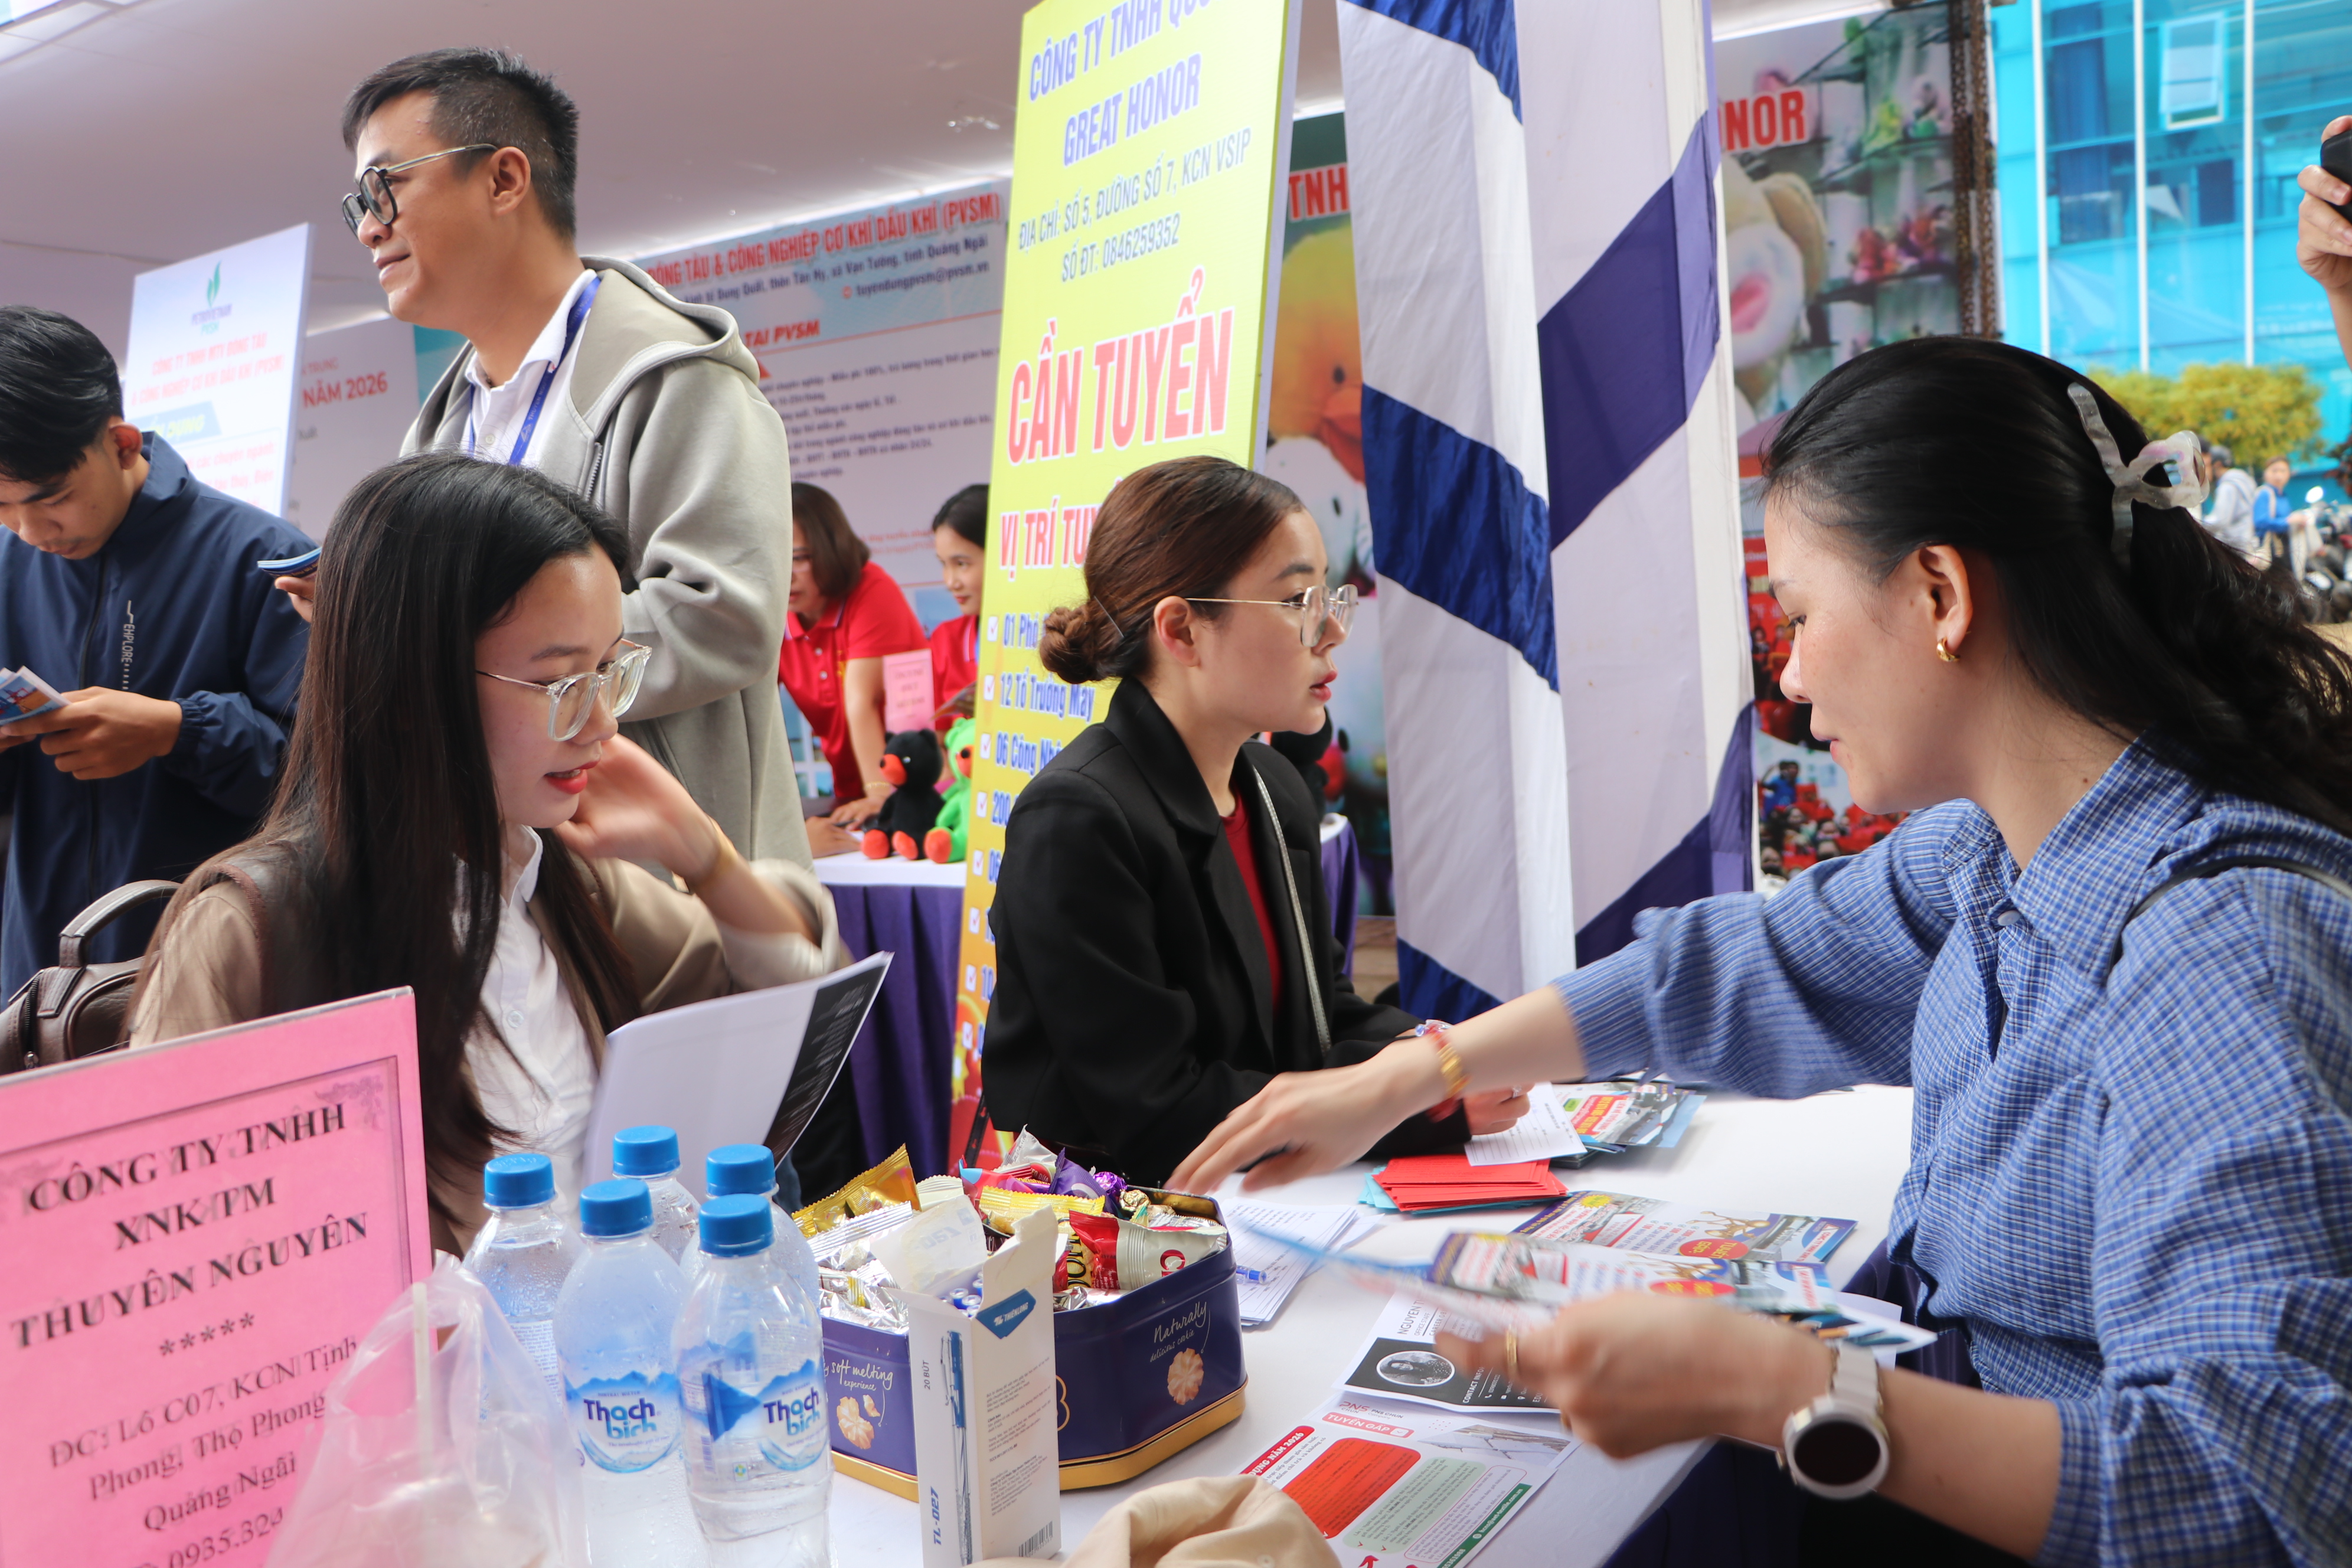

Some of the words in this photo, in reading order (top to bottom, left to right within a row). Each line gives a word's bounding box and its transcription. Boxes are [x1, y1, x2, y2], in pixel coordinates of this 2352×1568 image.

[1030, 32, 1078, 102] CÔNG
[1083, 15, 1106, 73] TY
[1064, 92, 1122, 167] GREAT
[1126, 52, 1201, 138] HONOR
[1718, 90, 1805, 152] NOR
[1020, 216, 1037, 254] ĐỊA
[1064, 187, 1083, 233] SỐ
[1082, 195, 1092, 228] 5,
[1096, 174, 1140, 219] ĐƯỜNG
[1144, 151, 1166, 202] SỐ
[1167, 159, 1177, 195] 7,
[1182, 143, 1212, 187] KCN
[1216, 127, 1252, 172] VSIP
[685, 252, 709, 282] TÀU
[714, 253, 724, 276] &
[728, 243, 765, 273] CÔNG
[769, 229, 819, 263] NGHIỆP
[824, 223, 844, 253] CƠ
[847, 214, 872, 247] KHÍ
[911, 201, 937, 234] KHÍ
[942, 192, 1000, 228] (PVSM)
[1062, 237, 1080, 282] SỐ
[1080, 243, 1099, 276] ĐT:
[1103, 212, 1181, 268] 0846259352
[773, 319, 821, 343] PVSM
[1008, 318, 1083, 465] CẦN
[1093, 266, 1234, 452] TUYỂN
[303, 379, 342, 409] NĂM
[346, 371, 388, 400] 2026
[1000, 511, 1020, 581] VỊ
[1024, 495, 1059, 567] TRÍ
[1004, 613, 1015, 648] 01
[1018, 612, 1039, 649] Phó
[1000, 672, 1012, 707] 12
[1030, 671, 1066, 720] Trưởng
[1069, 682, 1096, 723] May
[996, 731, 1008, 766] 06
[1011, 733, 1037, 778] Công
[991, 789, 1010, 828] 200
[29, 1153, 158, 1213] CÔNG
[172, 1136, 222, 1173] TY
[237, 1103, 345, 1155] TNHH
[115, 1198, 201, 1250] XNK
[214, 1178, 276, 1219] TM
[11, 1268, 198, 1349] THUYÊN
[210, 1214, 369, 1288] NGUYÊN
[1154, 1301, 1207, 1343] Naturally
[1397, 1306, 1422, 1335] NGUYEN
[1414, 1322, 1426, 1336] OFFICE
[1421, 1312, 1430, 1324] STAFF
[1429, 1318, 1442, 1336] CAREER
[1150, 1341, 1175, 1362] delicious
[1177, 1329, 1194, 1345] cookie
[832, 1359, 851, 1384] soft
[852, 1363, 893, 1390] melting
[844, 1380, 877, 1391] experience
[925, 1378, 930, 1390] 20
[1463, 1380, 1478, 1403] CONTACT
[51, 1429, 110, 1468] ĐC:
[119, 1410, 154, 1443] Lô
[164, 1386, 226, 1425] C07,
[234, 1358, 299, 1399] KCN
[304, 1335, 358, 1373] Tịnh
[1327, 1414, 1365, 1426] TUYỂN
[1340, 1401, 1370, 1412] PNS
[89, 1451, 184, 1502] Phong,
[193, 1427, 243, 1460] Thọ
[251, 1393, 326, 1438] Phong
[1249, 1459, 1270, 1475] DỤNG
[1268, 1446, 1286, 1461] NĂM
[1283, 1432, 1305, 1447] 2026
[1283, 1455, 1296, 1464] tham
[144, 1482, 231, 1531] Quảng
[239, 1452, 297, 1497] Ngãi
[930, 1486, 942, 1545] TL-027
